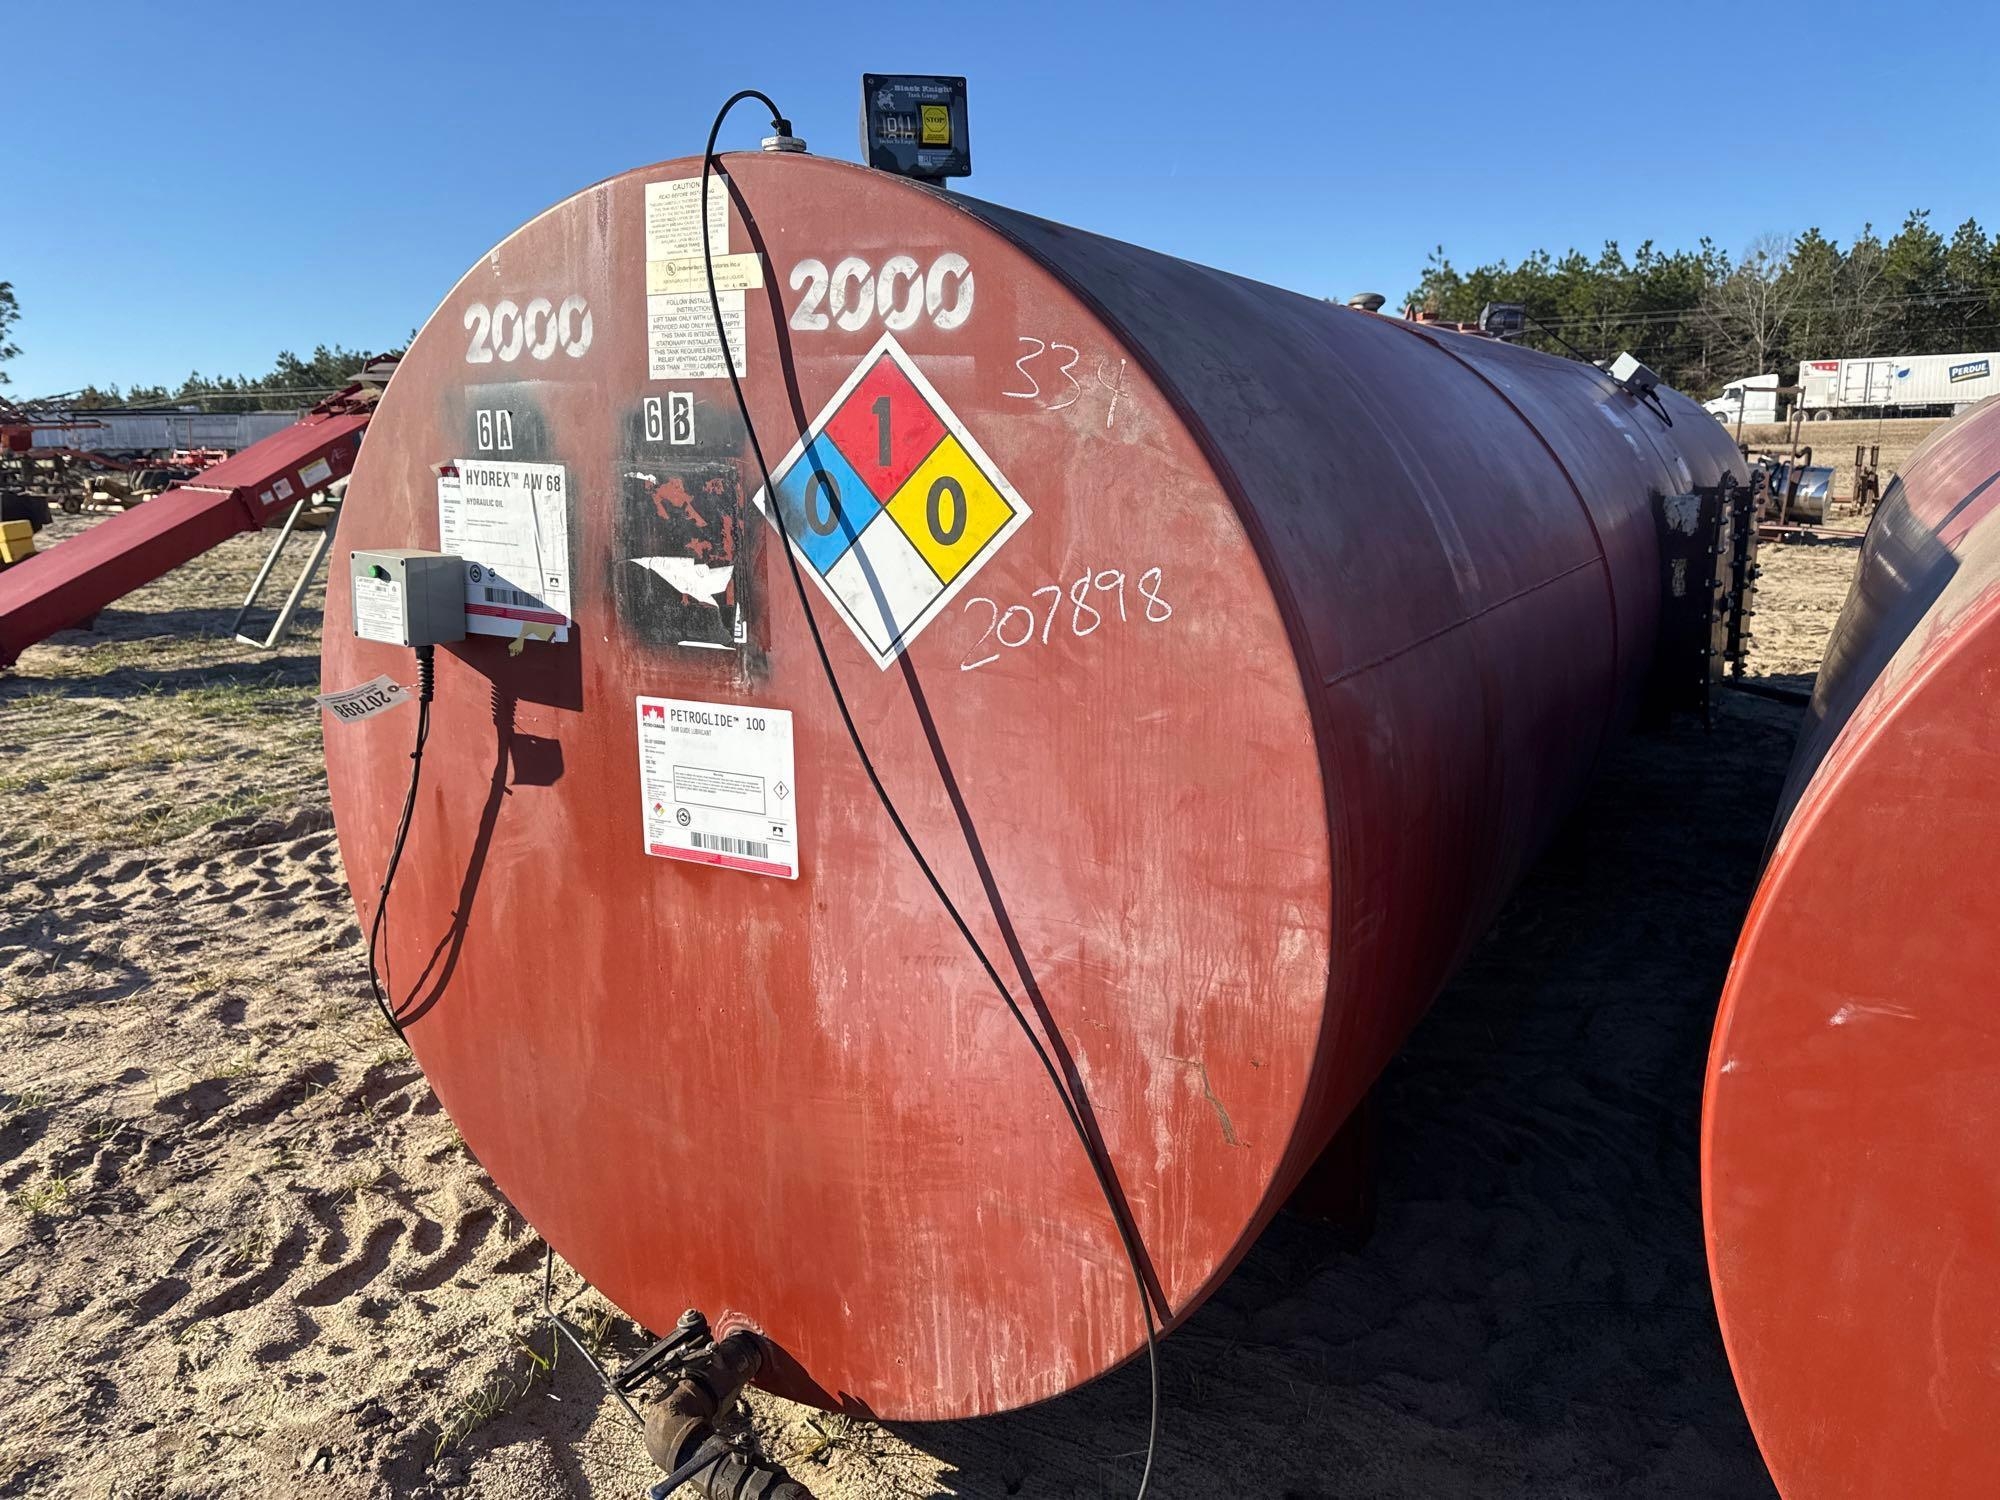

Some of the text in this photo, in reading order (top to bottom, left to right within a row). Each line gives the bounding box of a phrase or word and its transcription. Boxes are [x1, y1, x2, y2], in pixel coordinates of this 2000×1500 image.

[922, 85, 953, 94] Knight
[672, 182, 700, 190] CAUTION
[666, 298, 688, 306] FOLLOW
[789, 252, 975, 332] 2000
[463, 293, 594, 364] 2000
[664, 315, 677, 323] TANK
[678, 314, 692, 322] ONLY
[1952, 363, 1987, 377] PERDUE
[1003, 337, 1129, 429] 334
[872, 396, 892, 467] 1
[523, 472, 543, 490] AW
[546, 475, 561, 492] 68
[466, 498, 504, 508] HYDRAULIC OIL
[804, 470, 842, 537] 0
[926, 476, 968, 546] 0
[960, 567, 1173, 671] 207898
[333, 690, 392, 718] 207898
[746, 717, 766, 732] 100
